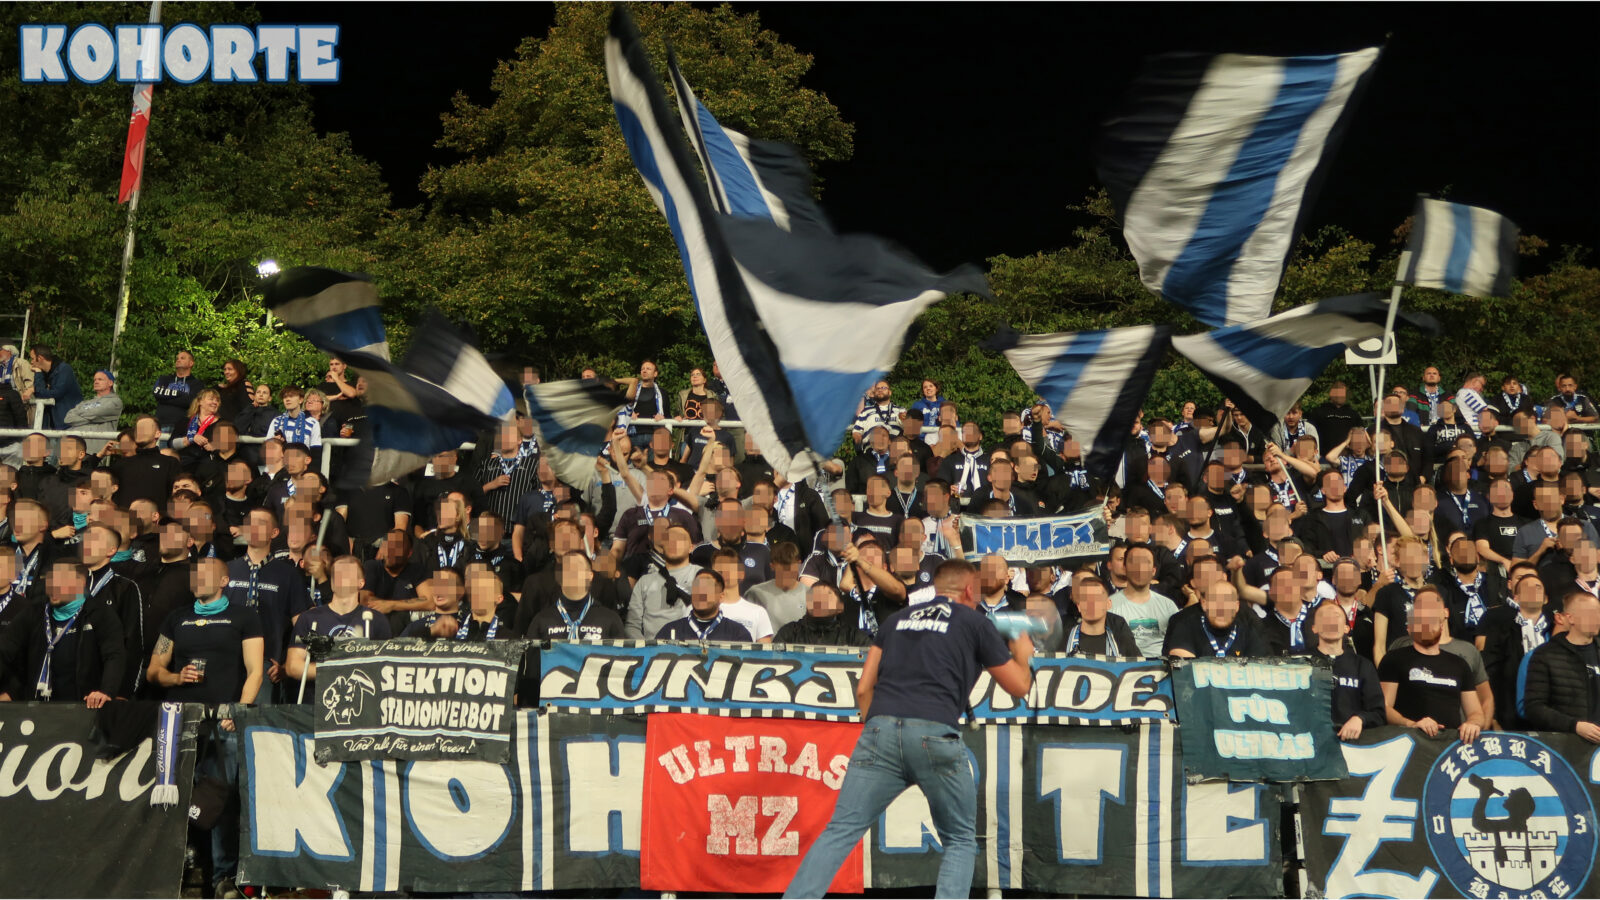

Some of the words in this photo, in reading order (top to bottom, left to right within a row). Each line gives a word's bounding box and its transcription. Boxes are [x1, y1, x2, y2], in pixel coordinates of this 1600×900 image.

[974, 522, 1094, 554] Niklas
[339, 639, 379, 653] Einer
[548, 625, 566, 635] new
[567, 625, 603, 634] bance
[380, 665, 508, 698] SEKTION
[1192, 662, 1313, 690] FREIHEIT
[380, 697, 506, 731] STADIONVERBOT
[1227, 693, 1290, 725] FÜR
[0, 719, 157, 802] ion
[1214, 729, 1315, 760] ULTRAS
[1440, 736, 1552, 782] ZEBRA
[658, 735, 851, 791] ULTRAS
[706, 794, 799, 856] MZ
